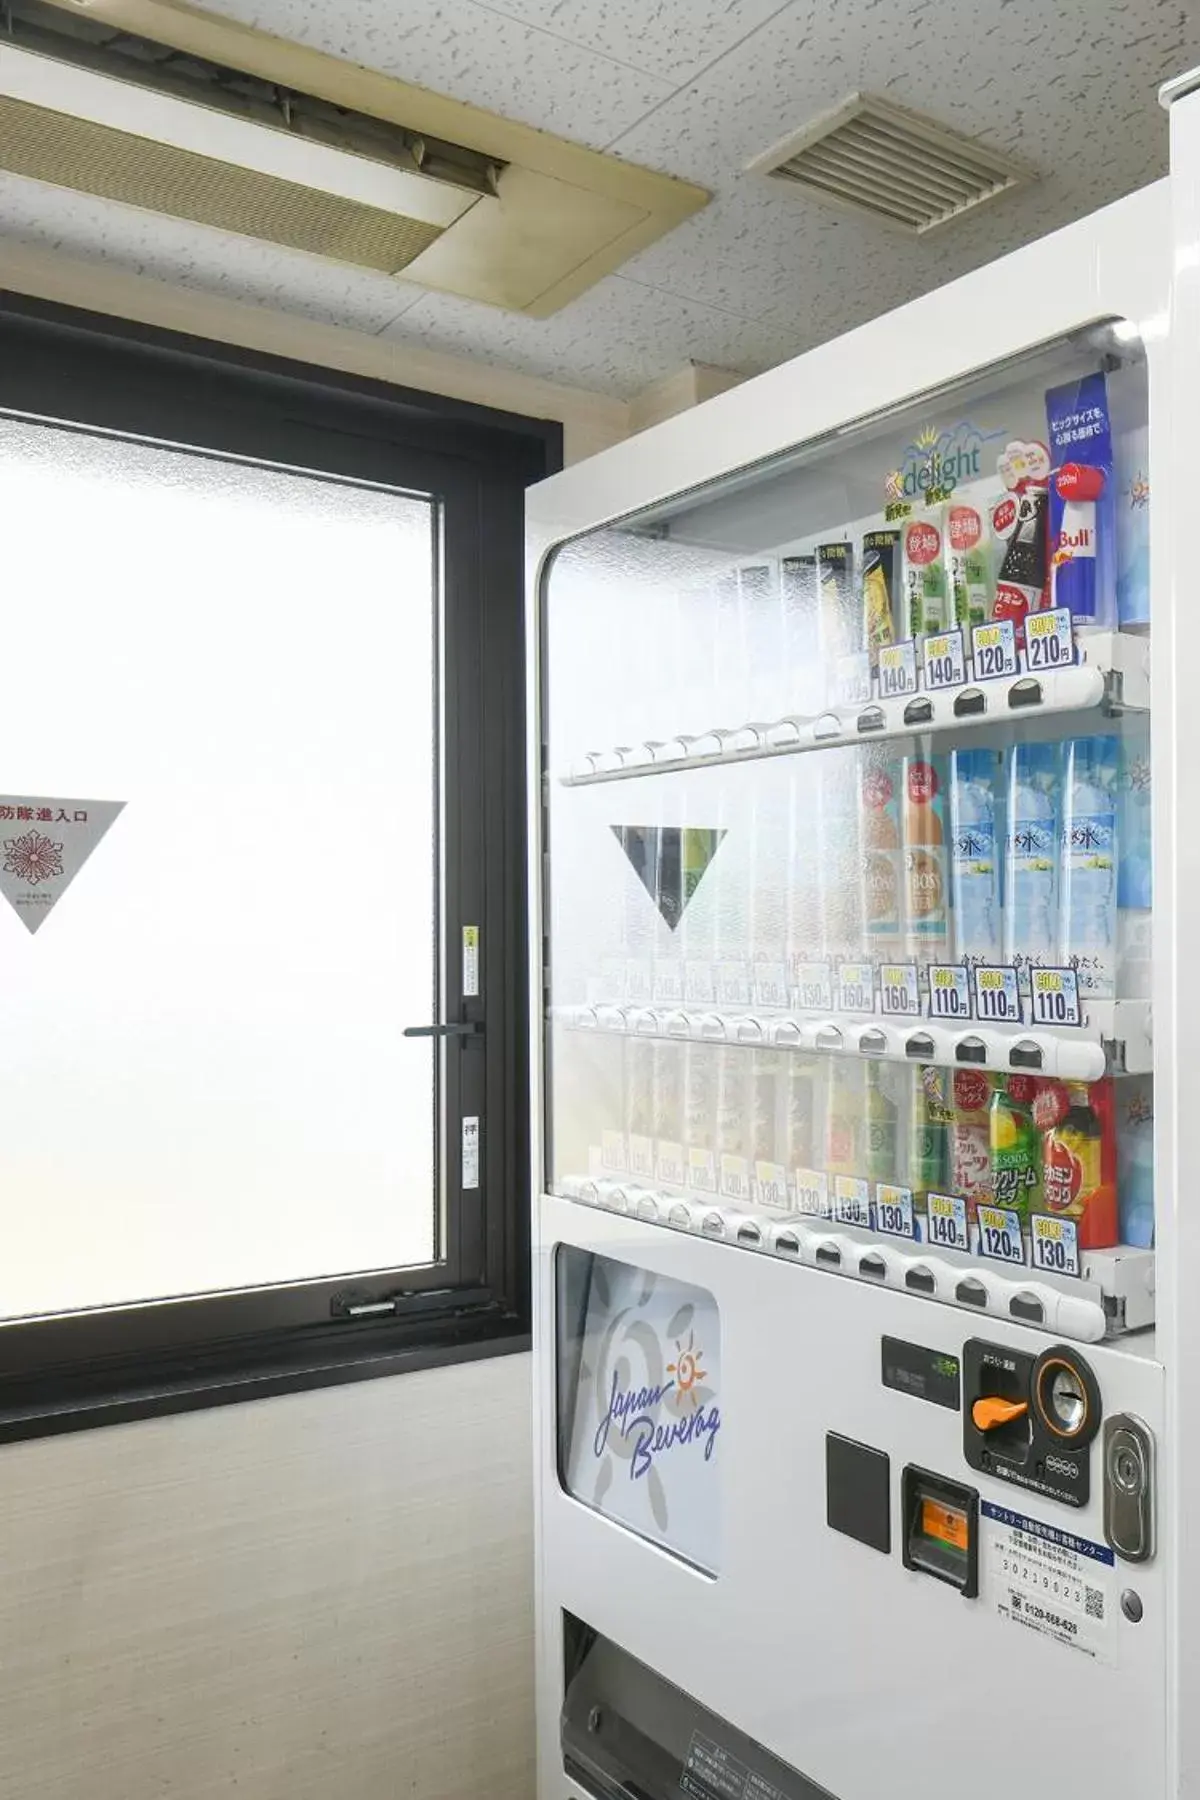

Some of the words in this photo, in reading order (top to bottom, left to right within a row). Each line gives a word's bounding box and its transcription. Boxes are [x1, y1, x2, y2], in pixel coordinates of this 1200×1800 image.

[977, 646, 1013, 676] 120円
[1031, 634, 1071, 666] 210円
[928, 658, 961, 685] 140円
[936, 988, 968, 1015] 110円
[981, 990, 1016, 1018] 110円
[1038, 993, 1075, 1021] 110円
[880, 1204, 911, 1234] 130円
[931, 1218, 964, 1247] 140円
[985, 1228, 1020, 1259] 120円
[1037, 1239, 1074, 1271] 130円
[595, 1370, 675, 1459] Japan
